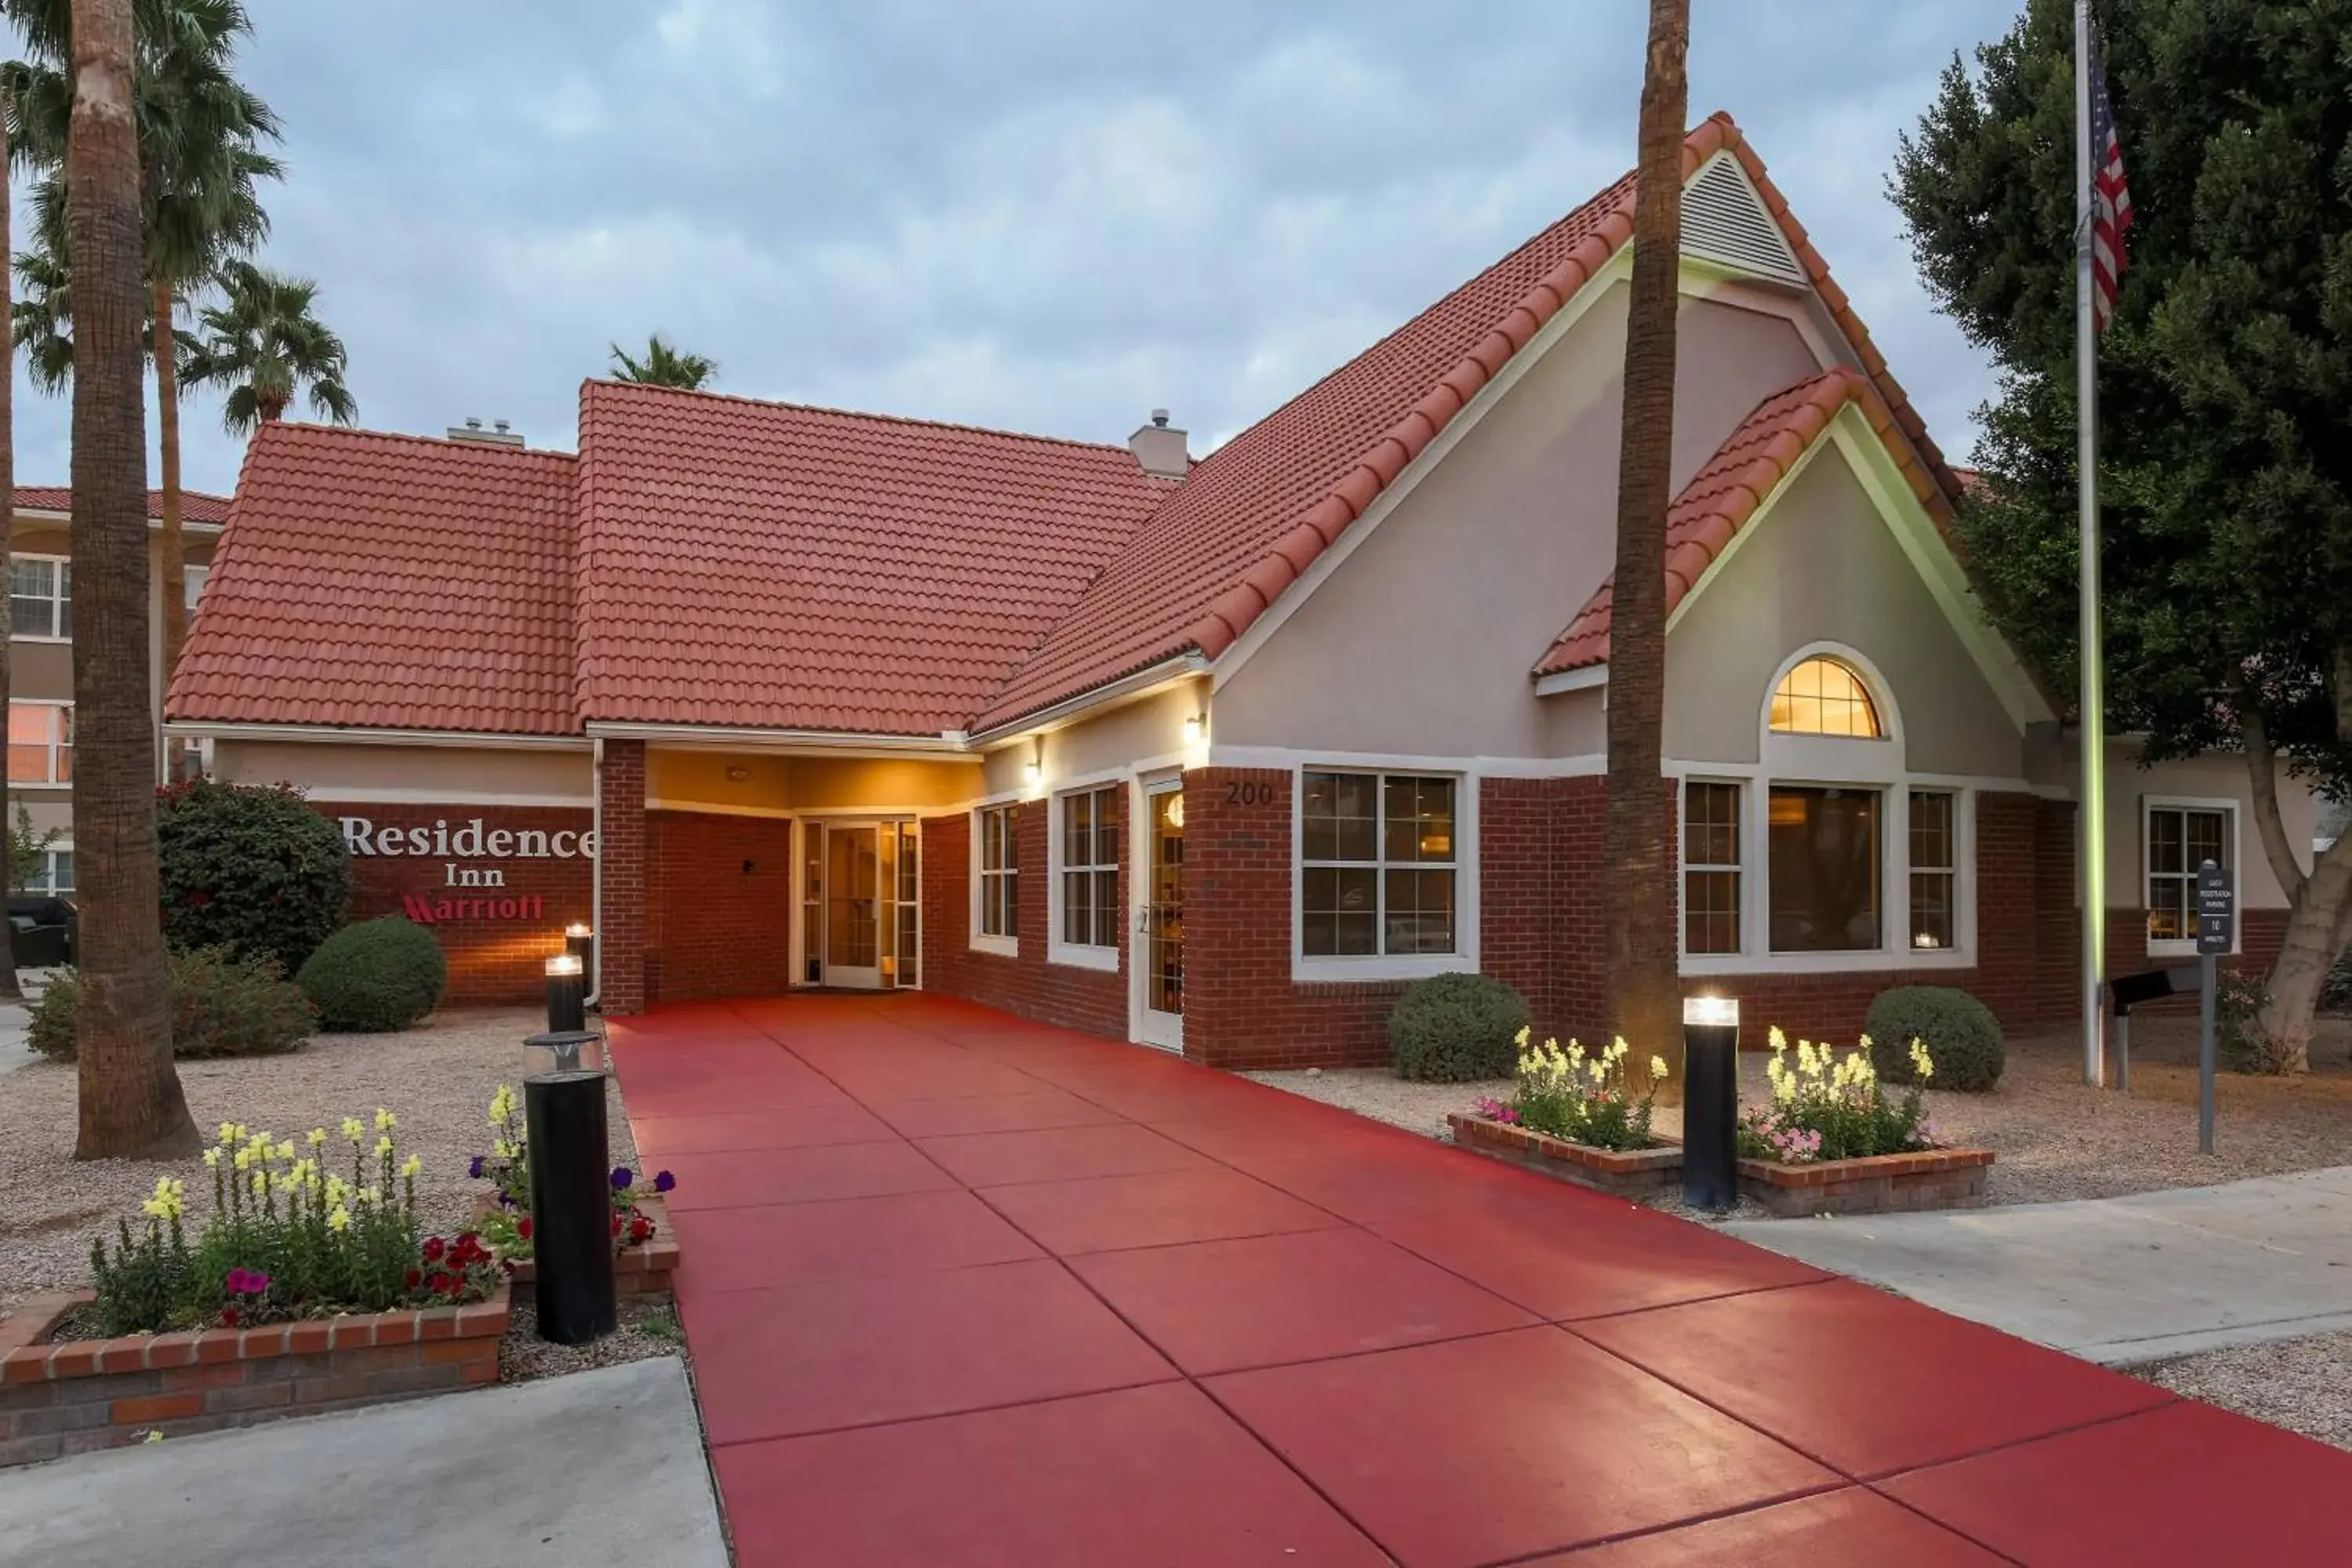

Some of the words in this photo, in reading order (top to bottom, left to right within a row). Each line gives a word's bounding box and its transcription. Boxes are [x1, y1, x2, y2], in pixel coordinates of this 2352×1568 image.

[1226, 782, 1272, 806] 200
[339, 816, 596, 858] Residence
[445, 862, 505, 887] Inn
[401, 893, 544, 923] Marriott
